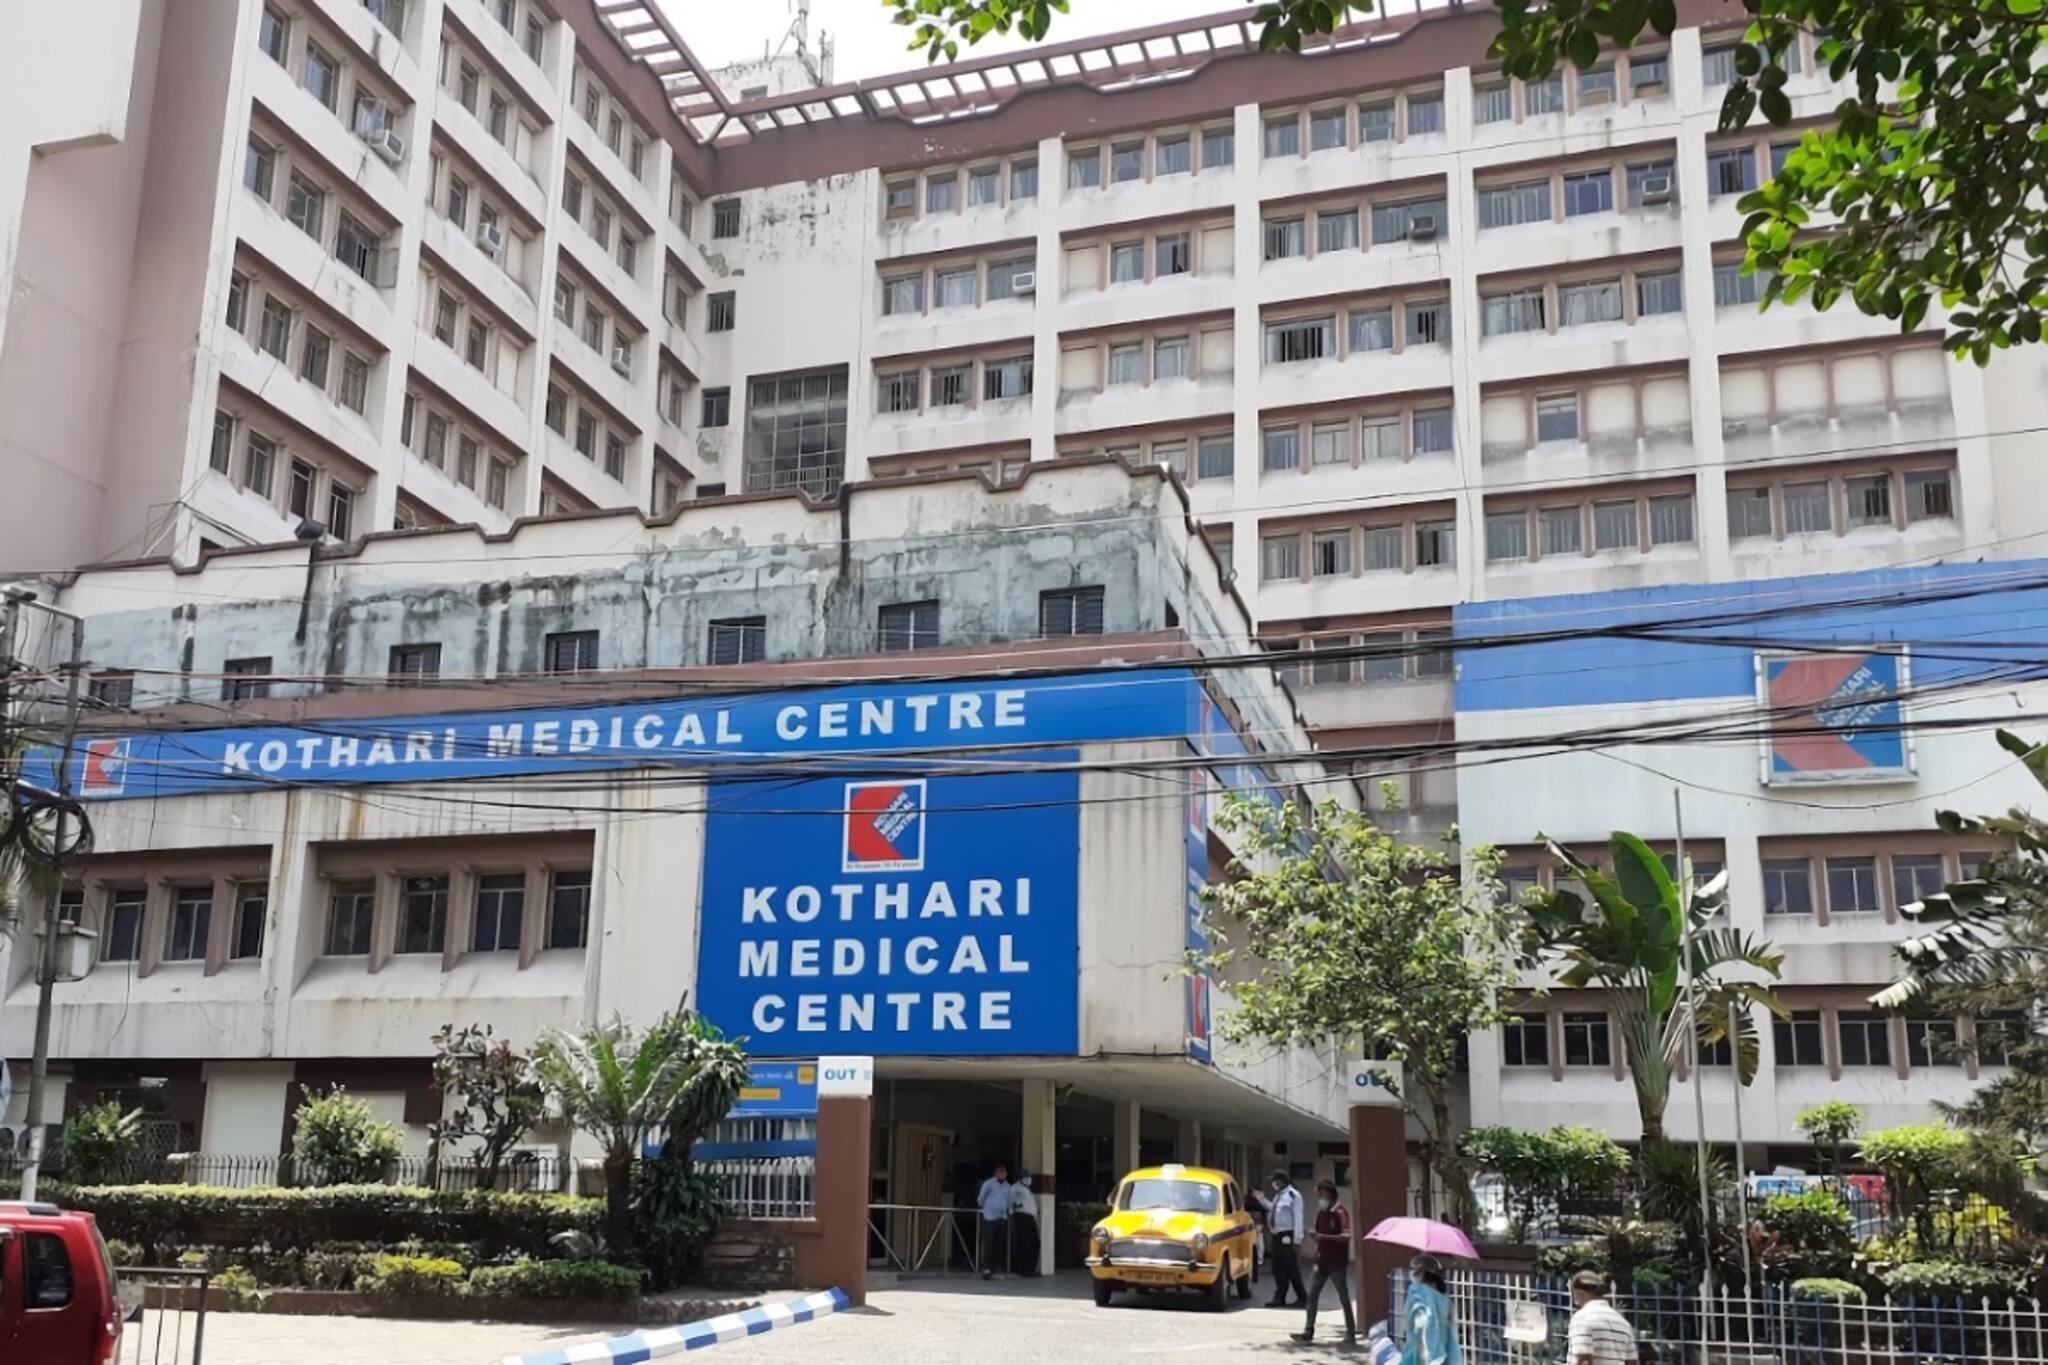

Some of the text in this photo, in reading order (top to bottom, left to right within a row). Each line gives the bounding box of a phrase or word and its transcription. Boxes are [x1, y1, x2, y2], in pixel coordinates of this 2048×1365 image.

[223, 690, 1026, 774] KOTHARI MEDICAL CENTRE
[742, 877, 1030, 924] KOTHARI
[739, 934, 1029, 977] MEDICAL
[752, 991, 1011, 1033] CENTRE
[824, 1068, 857, 1081] OUT
